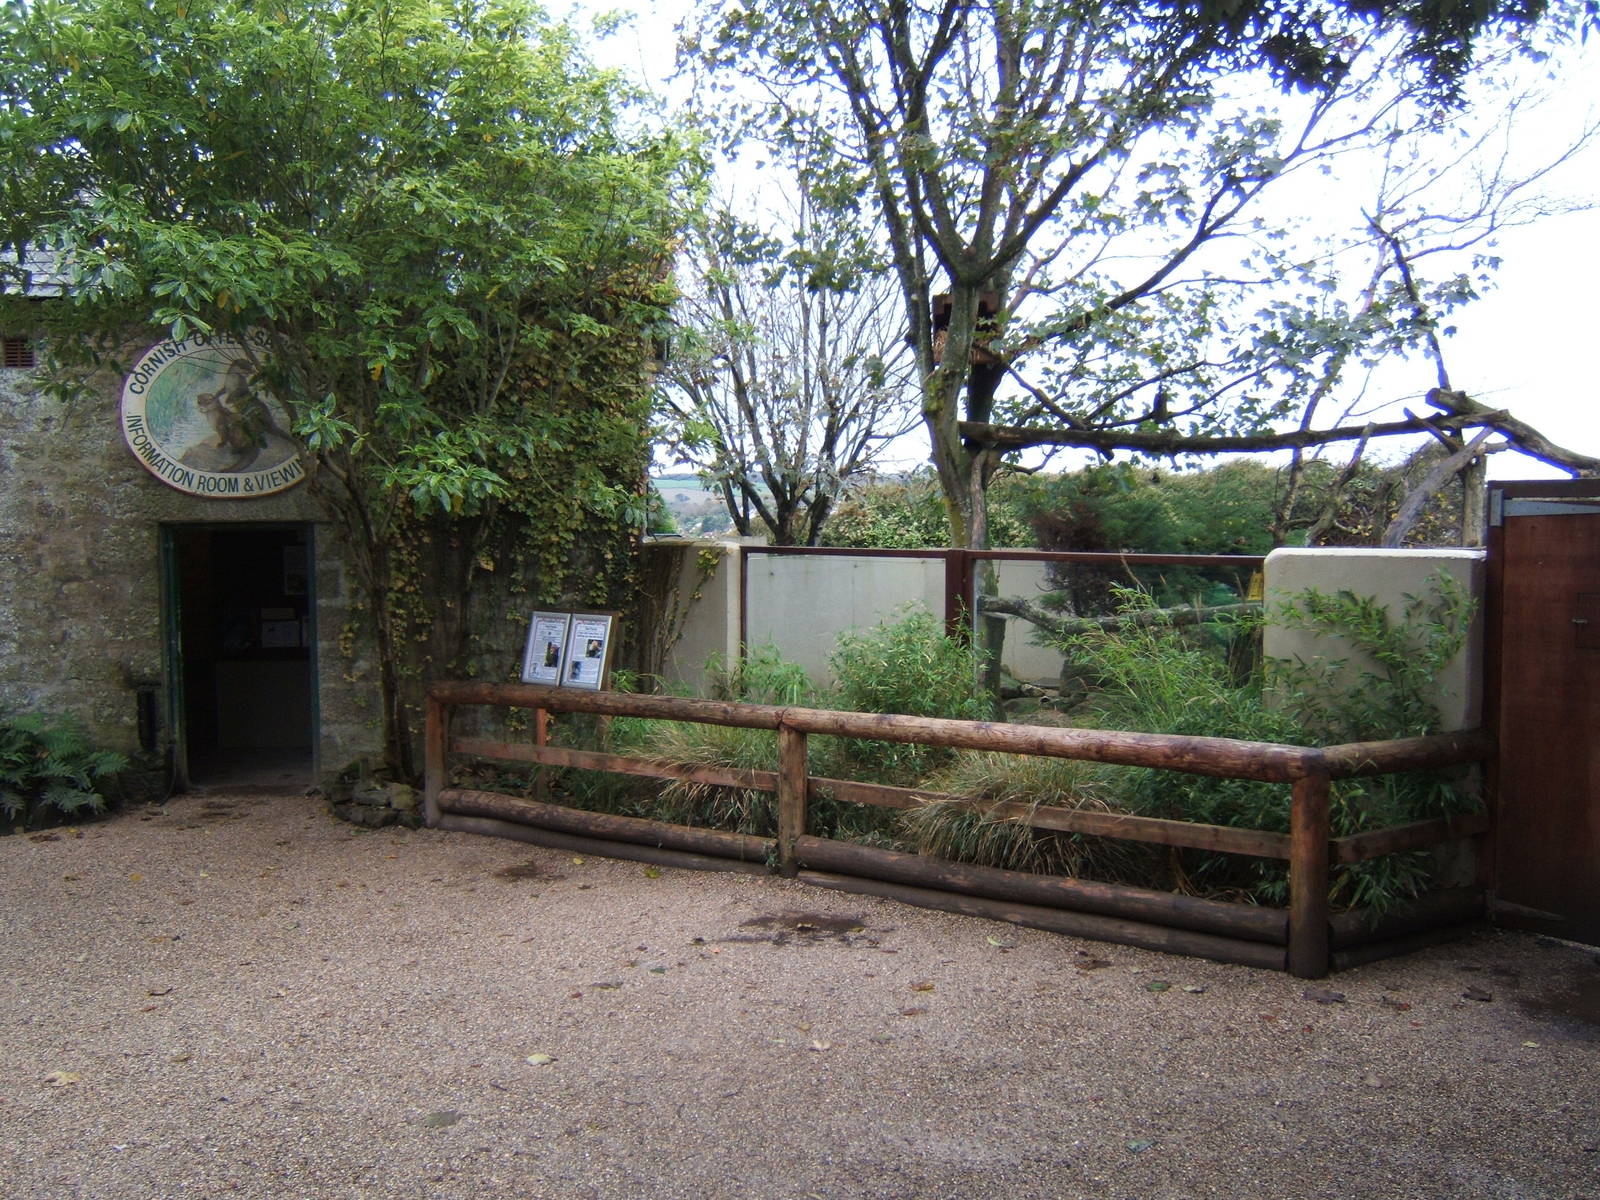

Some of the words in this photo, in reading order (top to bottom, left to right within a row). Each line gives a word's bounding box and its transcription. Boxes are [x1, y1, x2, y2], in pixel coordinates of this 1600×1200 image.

[129, 340, 187, 395] CORNISH
[126, 415, 195, 488] INFORMATION
[197, 476, 239, 493] ROOM
[244, 478, 254, 492] &
[254, 458, 304, 490] VIEWI
